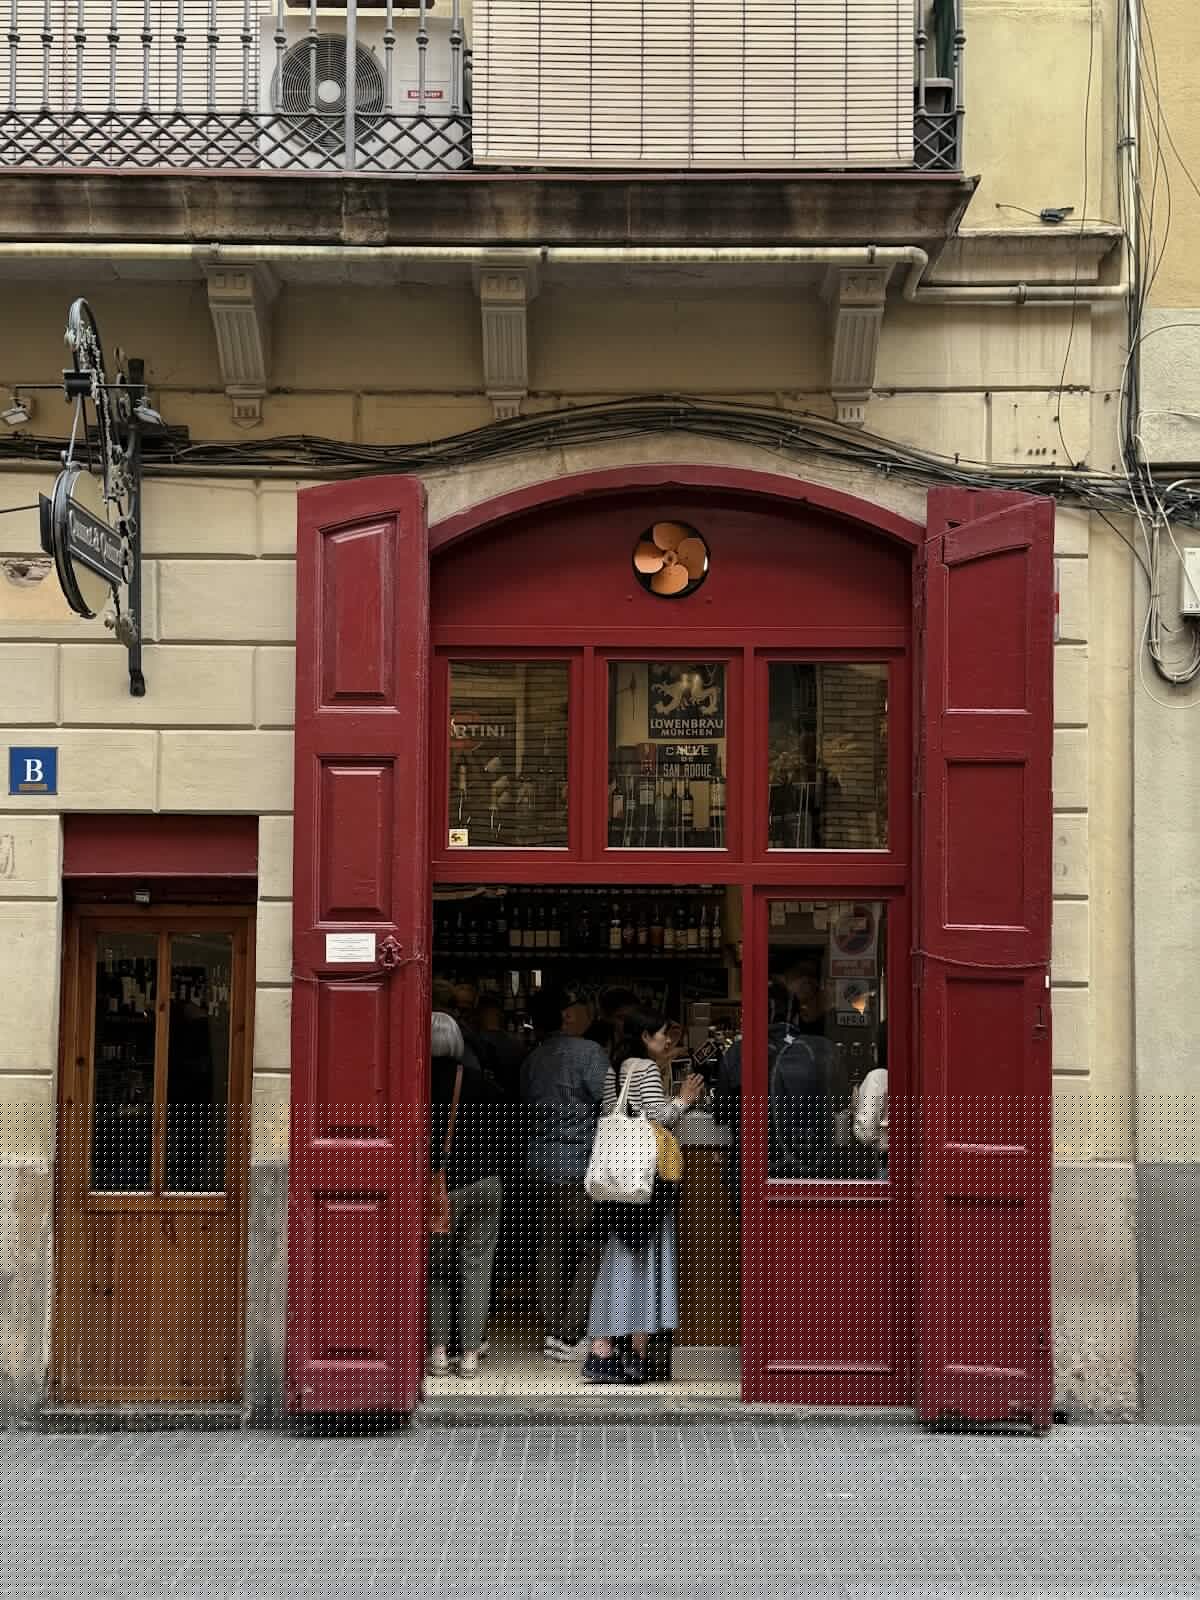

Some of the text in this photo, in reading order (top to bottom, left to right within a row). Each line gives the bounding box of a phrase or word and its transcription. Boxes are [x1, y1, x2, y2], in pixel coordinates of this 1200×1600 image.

[450, 724, 504, 737] RTINI
[23, 758, 44, 782] B
[663, 763, 680, 777] SAN
